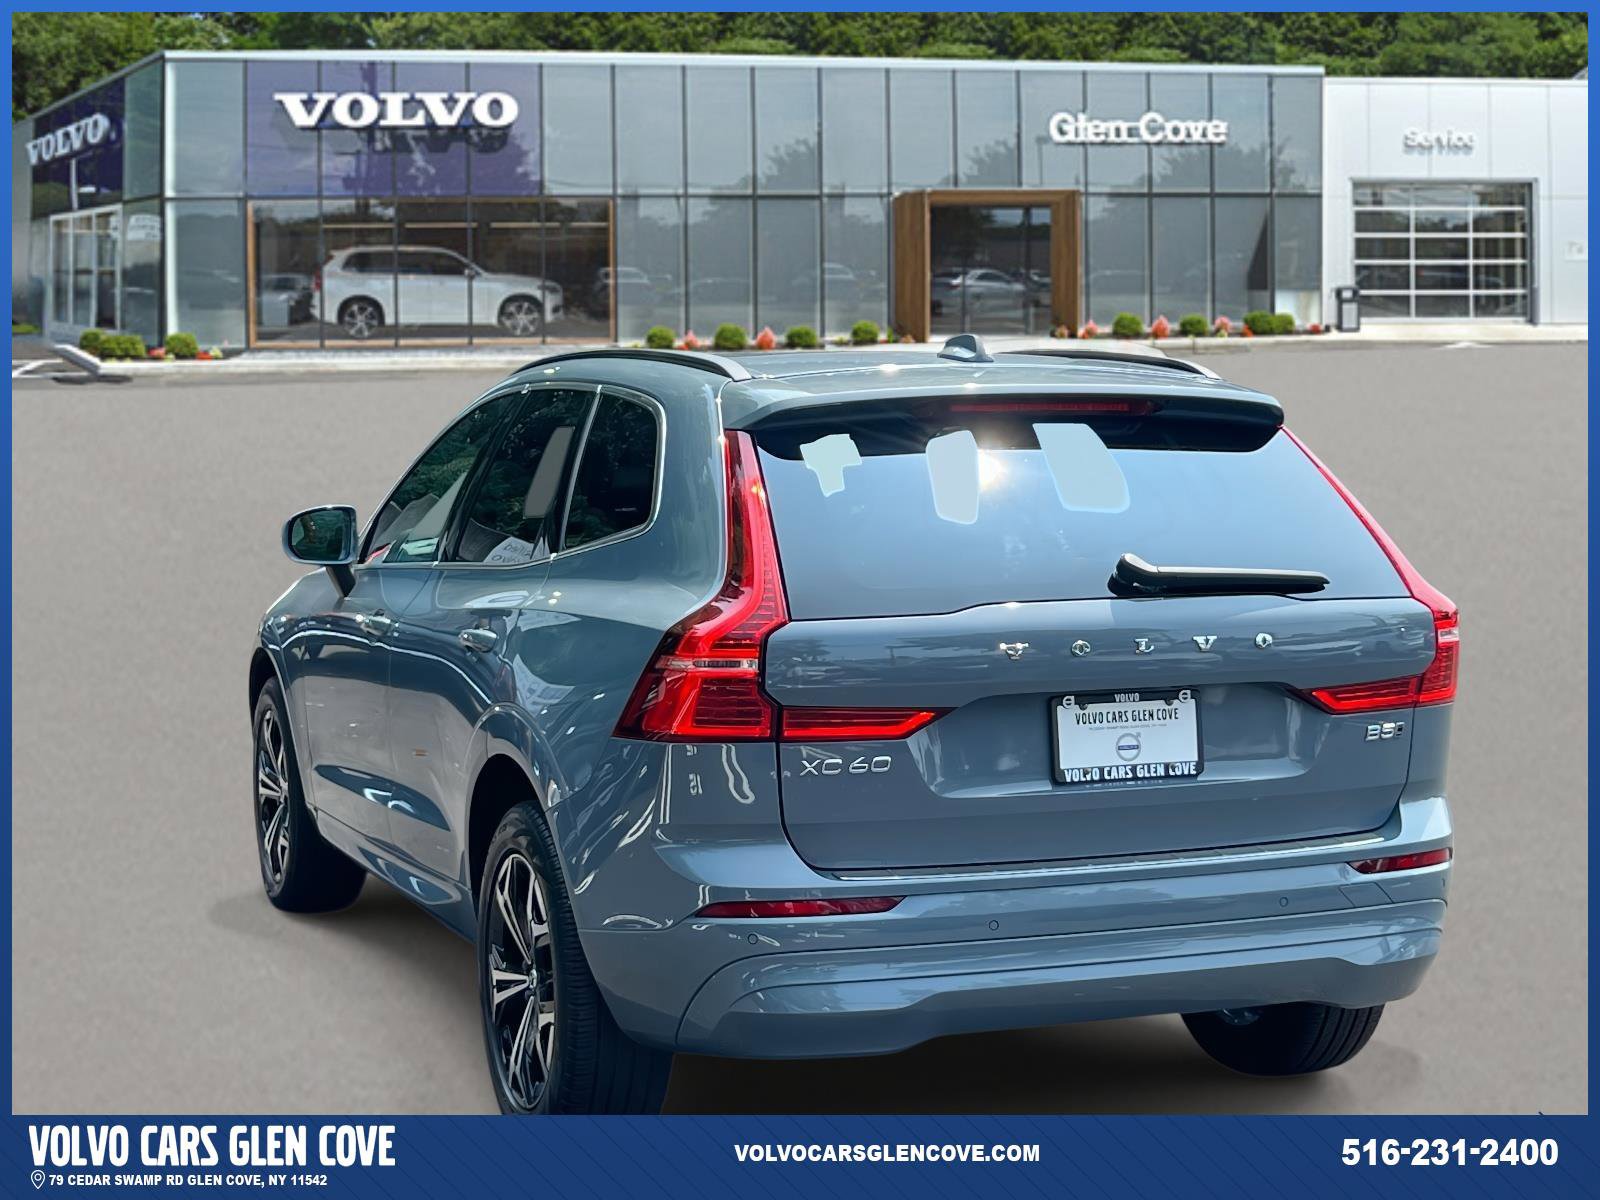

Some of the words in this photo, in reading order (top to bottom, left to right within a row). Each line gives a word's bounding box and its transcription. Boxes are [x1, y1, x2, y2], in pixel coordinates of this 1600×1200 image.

[273, 91, 519, 127] VOLVO
[26, 113, 110, 165] VOLVO
[1049, 111, 1138, 143] Glen
[1139, 111, 1228, 143] Cove
[1403, 127, 1476, 154] Service
[1114, 693, 1140, 702] VOLVO
[1075, 711, 1103, 725] VOLVO
[1106, 710, 1129, 723] CARS
[1132, 708, 1154, 722] GLEN
[1156, 707, 1179, 720] COVE
[1104, 765, 1133, 779] CARS
[1136, 763, 1165, 778] GLEN
